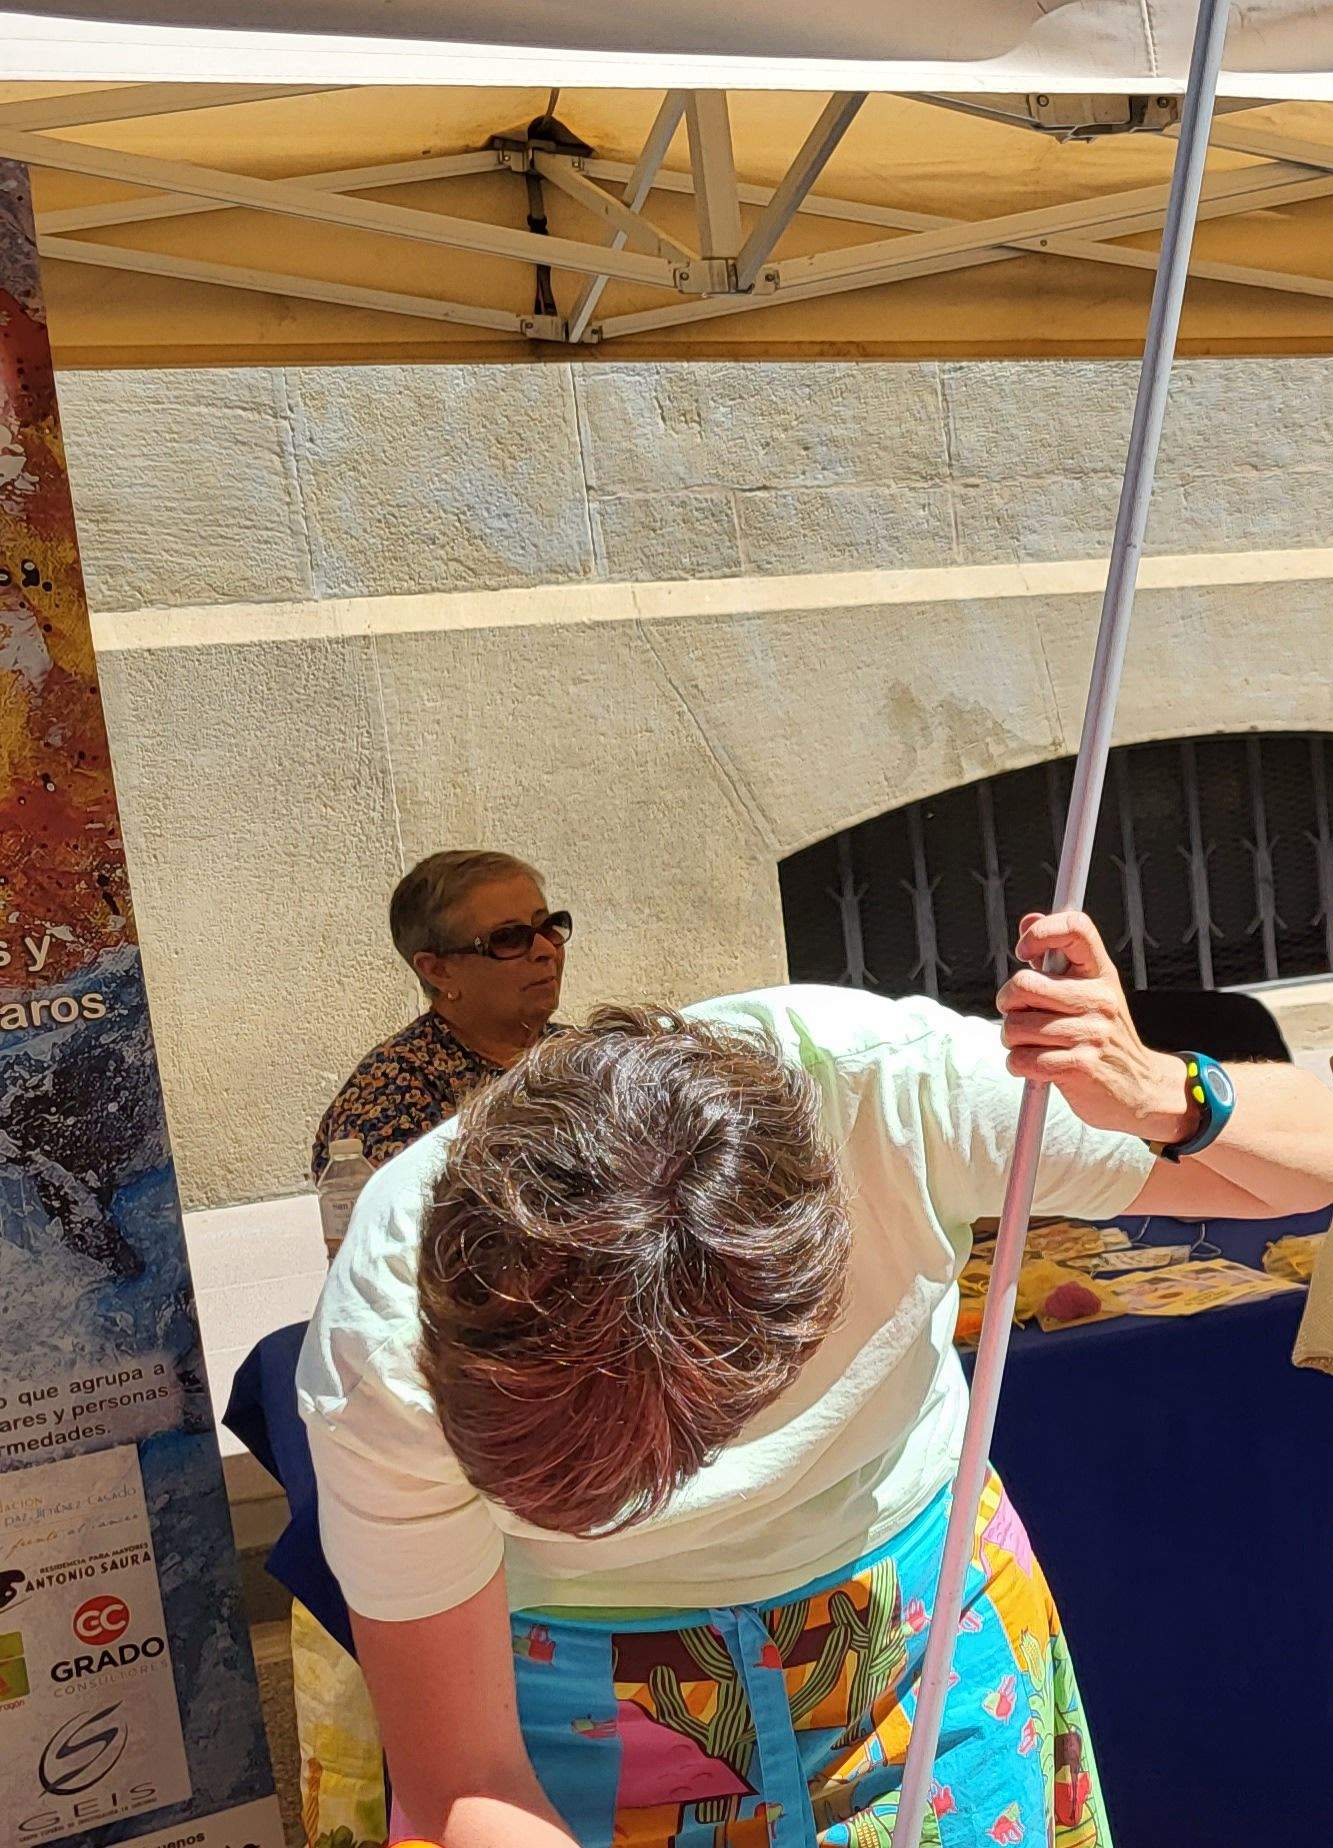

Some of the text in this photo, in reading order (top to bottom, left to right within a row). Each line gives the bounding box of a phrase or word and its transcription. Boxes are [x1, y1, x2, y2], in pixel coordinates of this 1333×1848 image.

[24, 935, 51, 972] y
[18, 1386, 59, 1406] que
[69, 1367, 144, 1394] agrupa
[153, 1363, 165, 1376] a
[53, 1408, 65, 1425] y
[72, 1385, 169, 1420] personas
[25, 1551, 152, 1593] ANTONIO SAURA
[40, 1542, 149, 1574] RESIDENCIA PARA MAYORES
[51, 1636, 165, 1683] GRADO
[18, 1782, 156, 1832] GEIS
